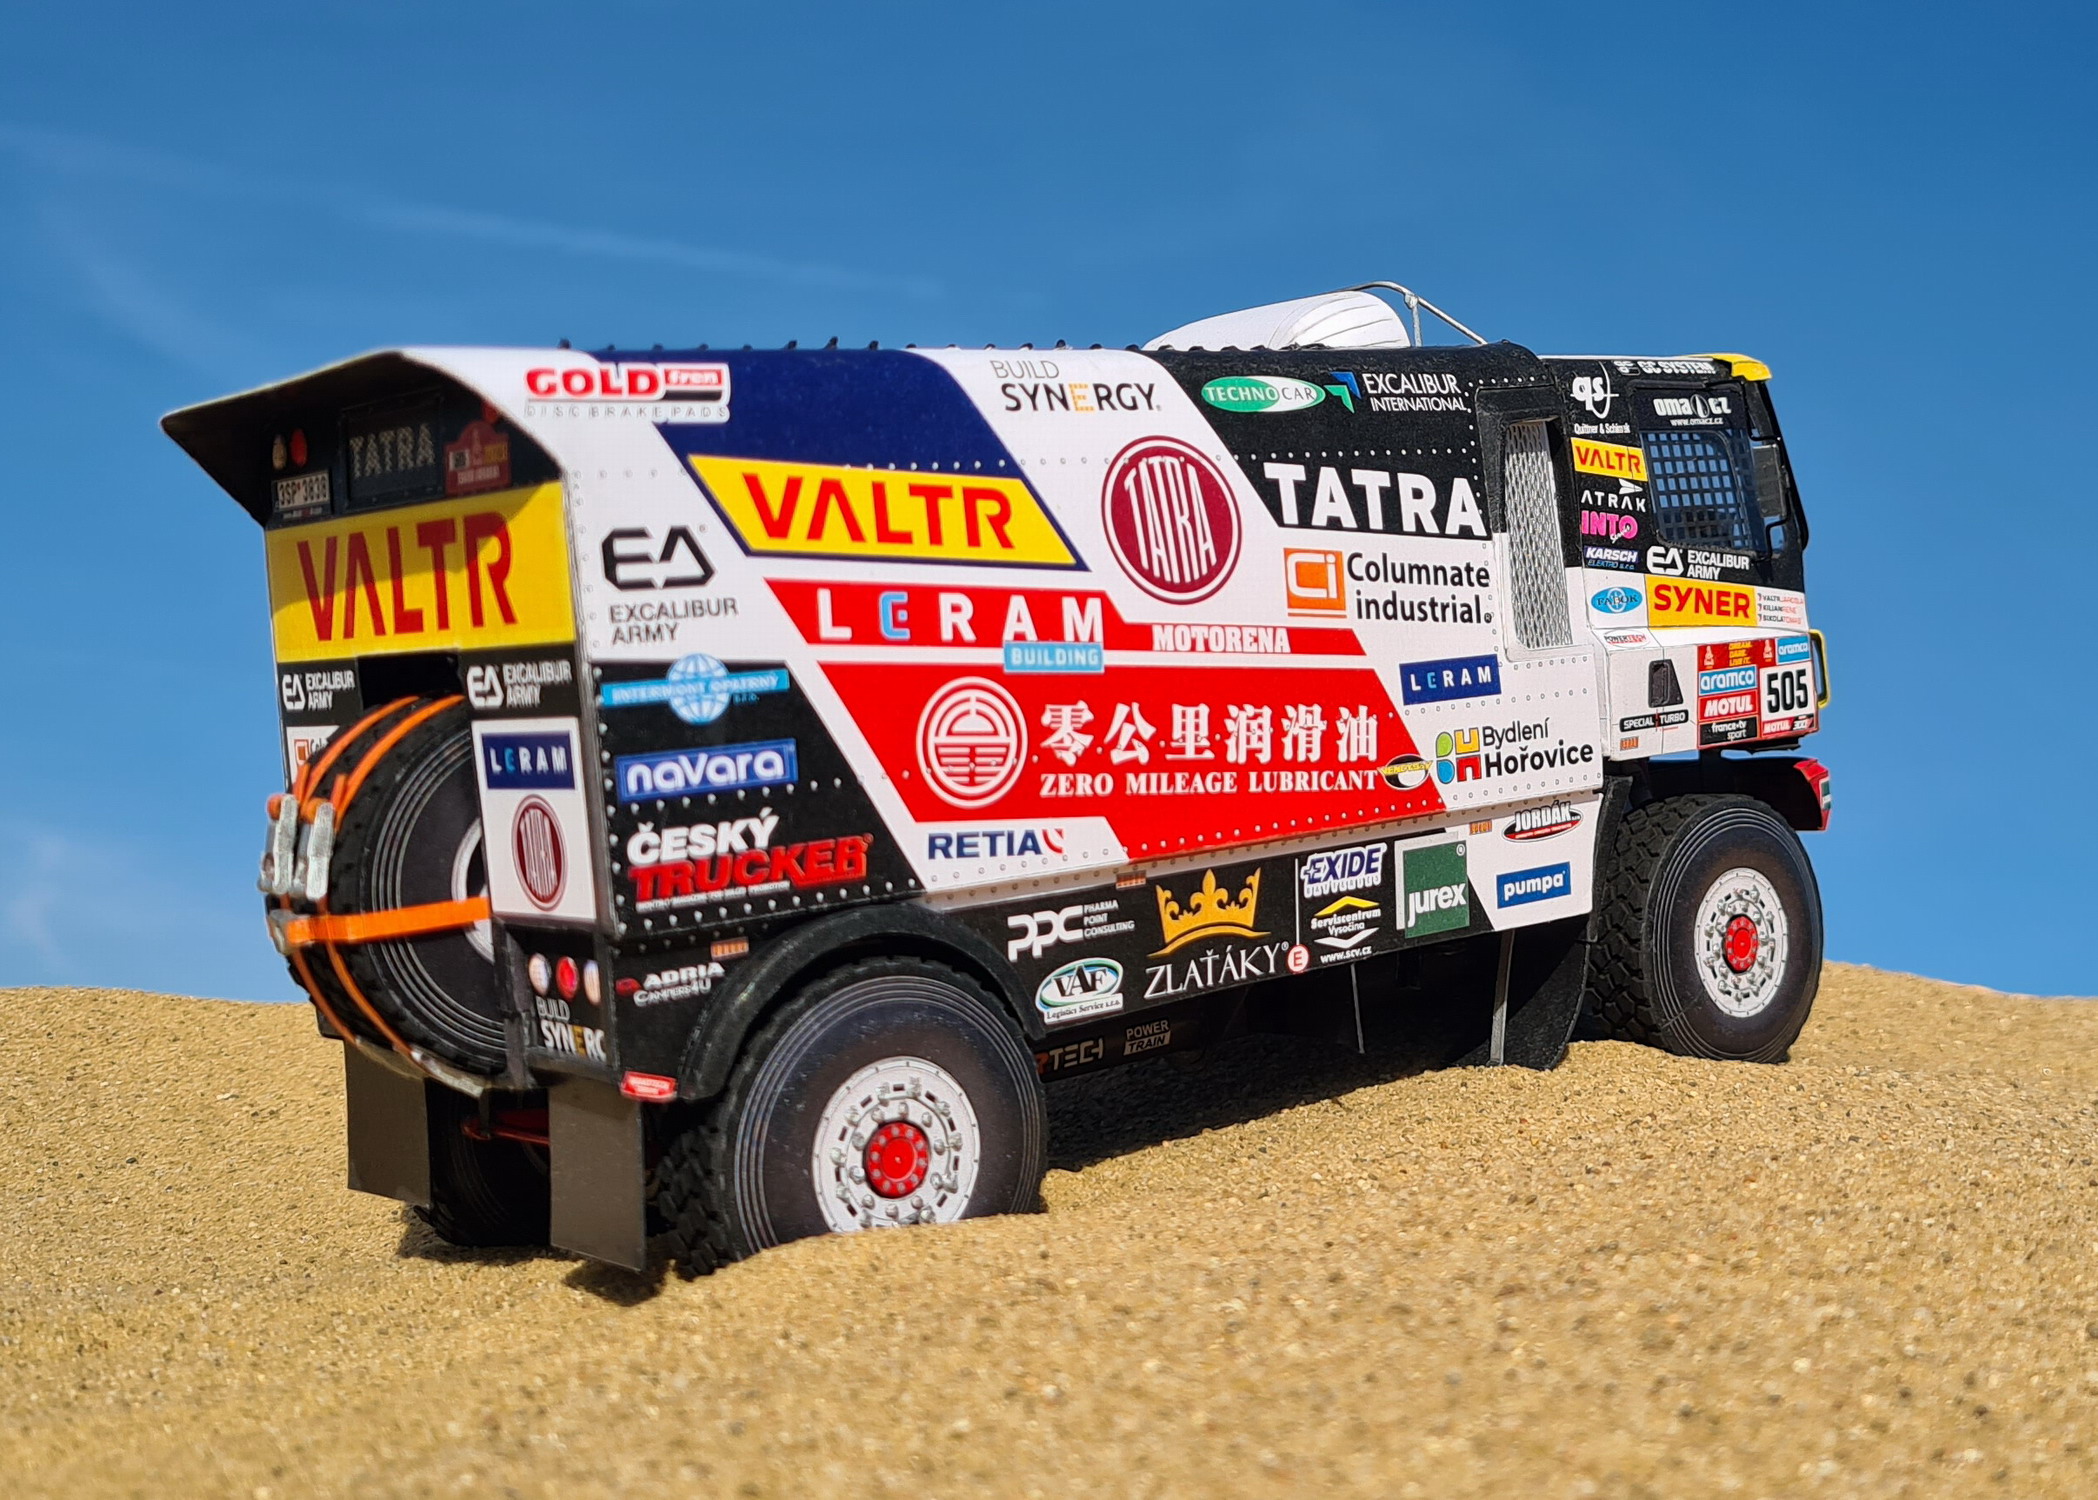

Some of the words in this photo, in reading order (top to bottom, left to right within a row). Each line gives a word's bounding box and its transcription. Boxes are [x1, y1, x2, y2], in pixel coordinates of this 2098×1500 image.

[526, 369, 660, 396] GOLD
[990, 360, 1059, 379] BUILD
[1001, 383, 1155, 412] SYNERGY
[1362, 373, 1461, 395] EXCALIBUR
[524, 405, 580, 418] DISC
[588, 405, 662, 418] BRAKE
[670, 405, 728, 418] PADS
[1370, 397, 1467, 413] INTERNATIONAL
[350, 424, 436, 478] TATRA
[1575, 446, 1641, 474] VALTR
[742, 473, 1015, 549] VALTR
[1263, 462, 1487, 537] TATRA
[1581, 489, 1646, 513] ATRAK
[1581, 510, 1638, 539] INTO
[1586, 547, 1638, 562] KARSCH
[1688, 549, 1750, 571] EXCALIBUR
[297, 512, 518, 641] VALTR
[1347, 552, 1490, 587] Columnate
[1687, 564, 1721, 580] ARMY
[610, 597, 738, 624] EXCALIBUR
[817, 588, 1102, 642] LERAM
[1654, 584, 1750, 619] SYNER
[613, 622, 680, 645] ARMY
[1152, 624, 1291, 653] MOTORENA
[1011, 647, 1099, 666] BUILDING
[1779, 642, 1808, 655] aramco
[306, 671, 355, 691] EXCALIBUR
[503, 660, 572, 685] EXCALIBUR
[1411, 665, 1492, 692] LERAM
[1700, 670, 1754, 690] aramco
[308, 691, 333, 710] ARMY
[506, 685, 541, 708] ARMY
[1767, 669, 1809, 713] 505
[1704, 695, 1754, 717] MOTUL
[1041, 701, 1378, 766] 零公里润滑油
[1483, 717, 1550, 744] Bydlení
[1624, 714, 1654, 730] SPECIAL
[1660, 712, 1686, 725] TURBO
[1727, 729, 1746, 741] sport
[489, 746, 568, 774] LERAM
[1485, 739, 1593, 778] Hořovice
[626, 750, 785, 795] navara
[1040, 772, 1114, 797] ZERO
[1126, 771, 1237, 795] MILEAGE
[1249, 769, 1377, 793] LUBRICANT
[627, 806, 780, 866] ČESKÝ
[927, 829, 1042, 861] RETIA
[627, 835, 869, 901] TRUCKER
[1304, 847, 1381, 884] EXIDE
[1504, 872, 1564, 901] pumpa
[1084, 899, 1119, 913] PHARMA
[1084, 913, 1108, 925] POINT
[1408, 883, 1467, 928] jurex
[1084, 920, 1135, 937] CONSULTING
[1320, 946, 1373, 964] www.scv.cz
[643, 962, 725, 991] ADRIA
[1054, 965, 1107, 997] VAF
[1144, 941, 1281, 999] ZLAŤÁKY
[536, 995, 570, 1023] BUILD
[1079, 1002, 1104, 1013] Service
[1126, 1019, 1170, 1040] POWER
[1129, 1034, 1167, 1053] TRAIN
